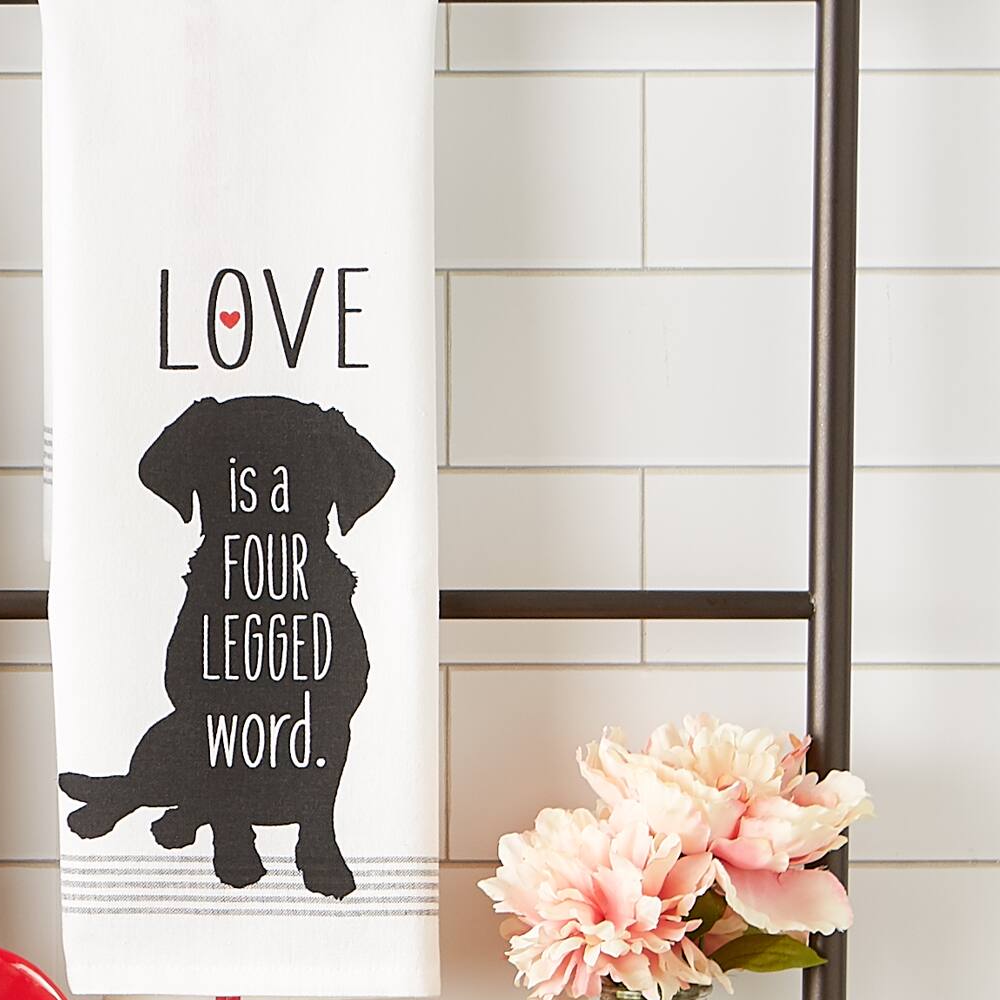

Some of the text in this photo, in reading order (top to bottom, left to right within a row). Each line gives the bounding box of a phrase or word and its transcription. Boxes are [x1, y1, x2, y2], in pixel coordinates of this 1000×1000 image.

[159, 267, 369, 371] LOVE
[229, 457, 290, 513] is a
[224, 533, 309, 601] FOUR
[202, 612, 333, 682] LEGGED
[206, 690, 326, 768] word.
